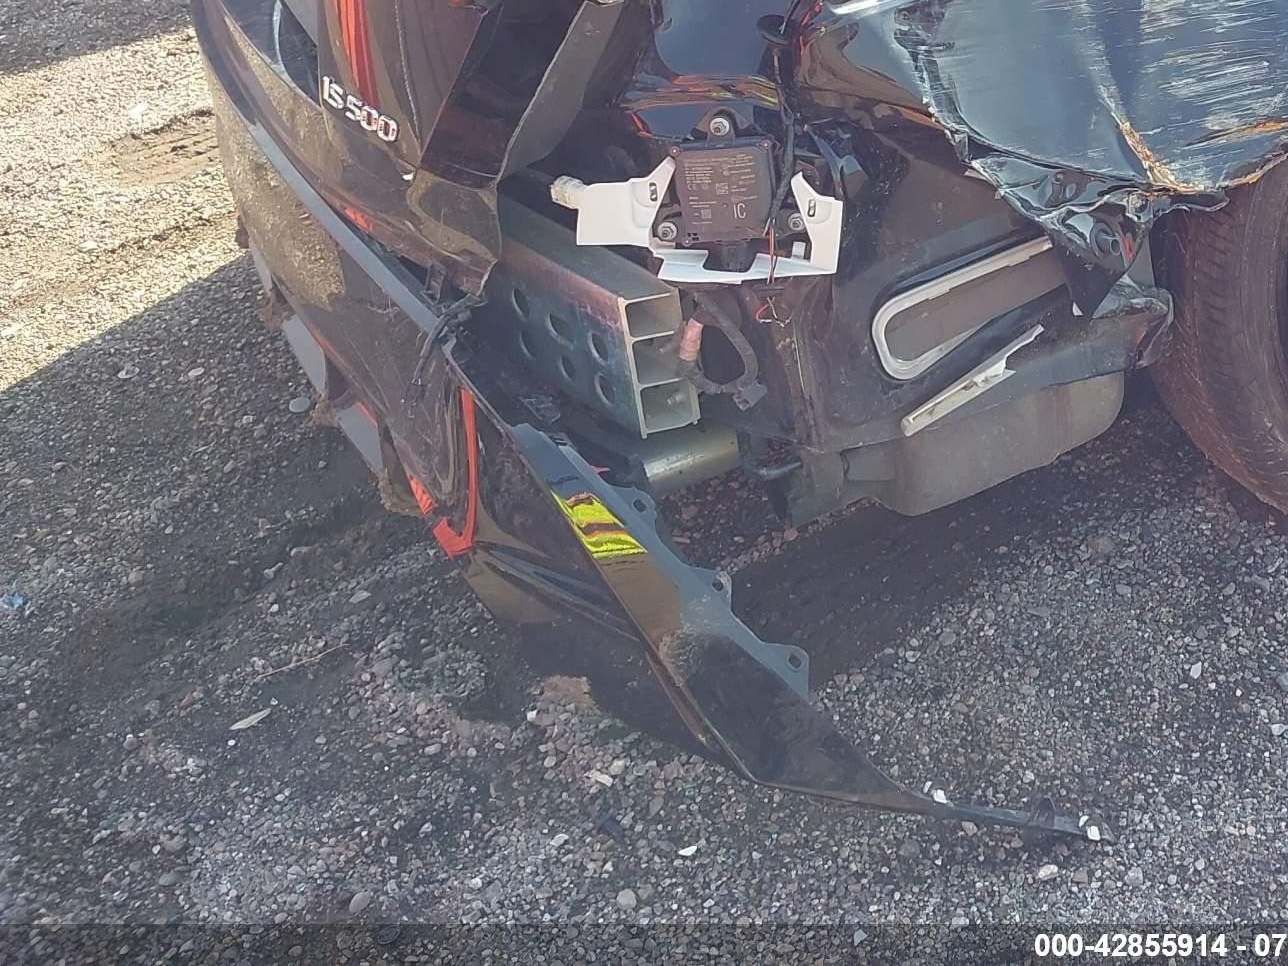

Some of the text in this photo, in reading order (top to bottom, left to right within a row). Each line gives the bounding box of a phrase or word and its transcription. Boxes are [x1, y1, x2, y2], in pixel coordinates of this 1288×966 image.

[322, 75, 398, 142] IS 500
[734, 203, 746, 219] IC
